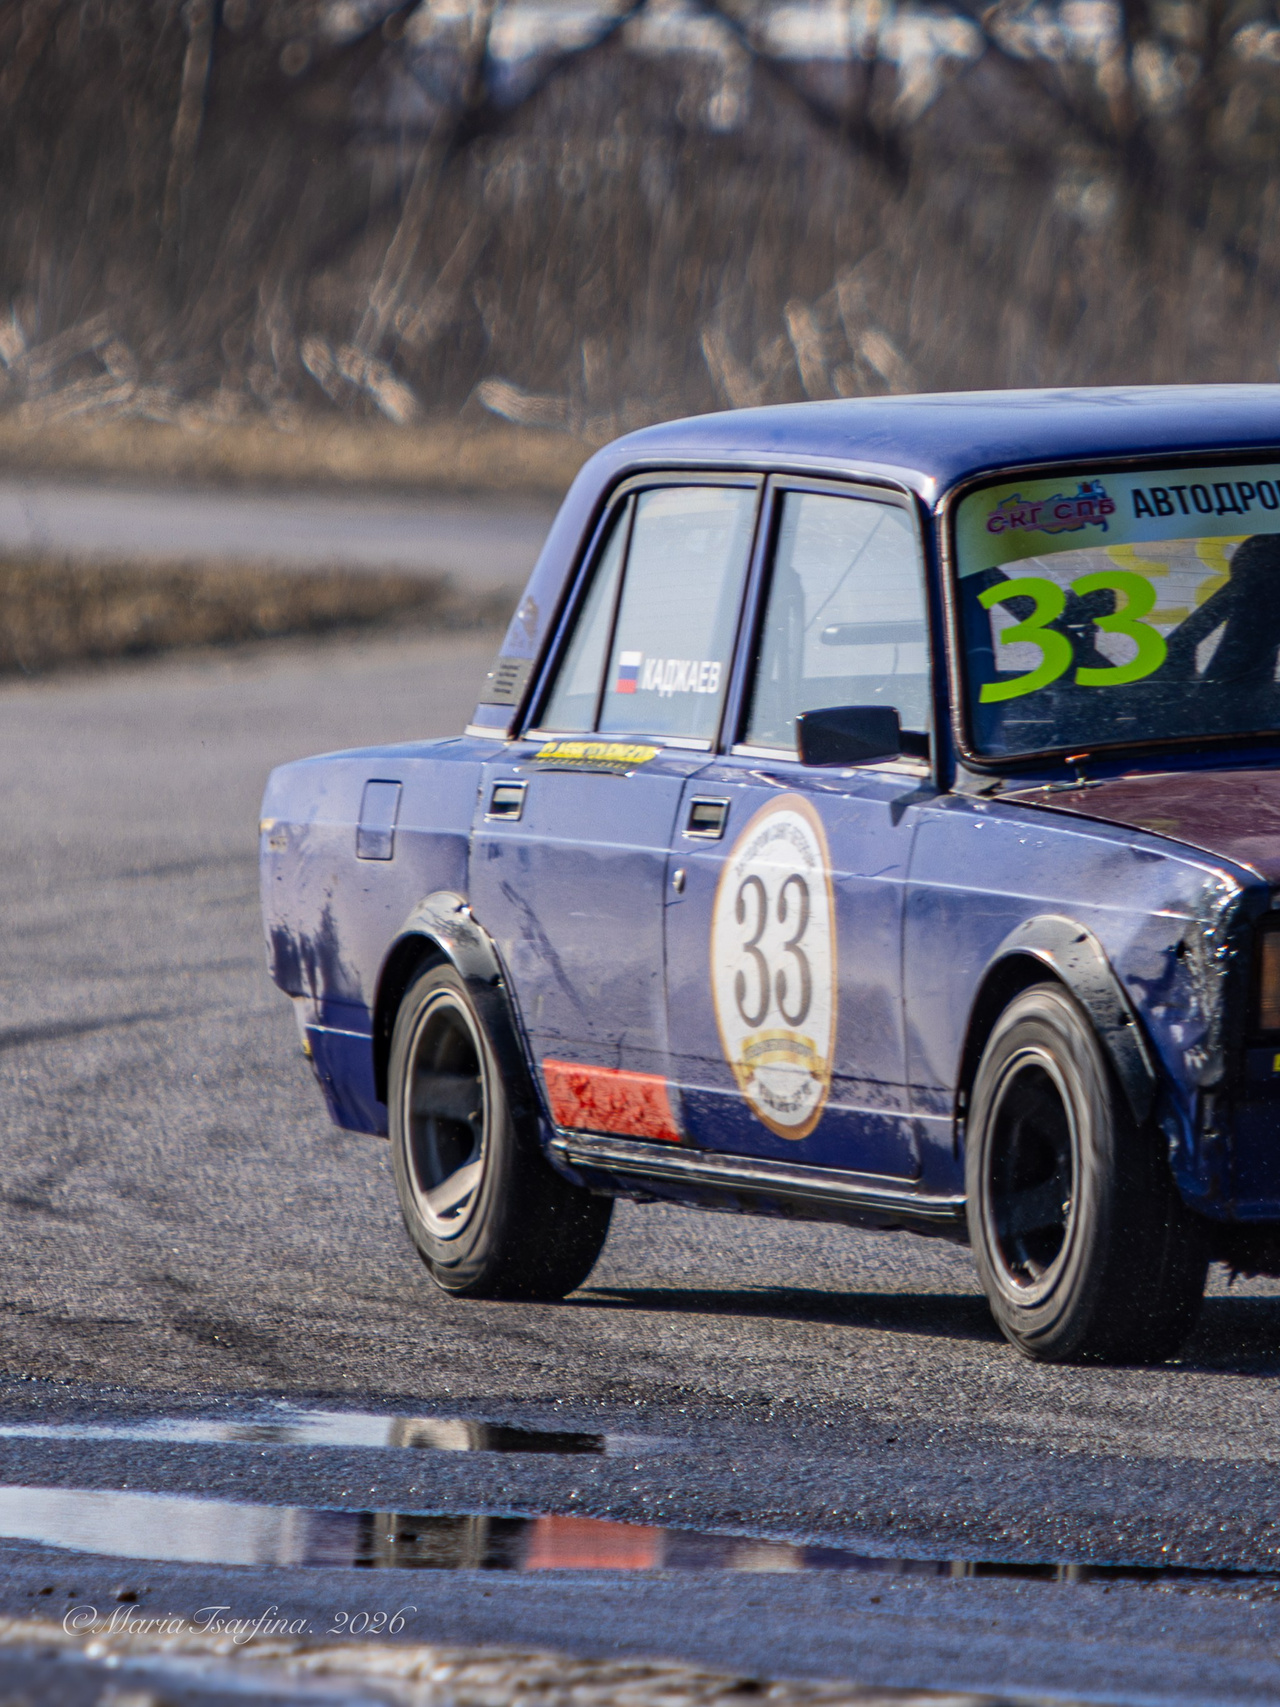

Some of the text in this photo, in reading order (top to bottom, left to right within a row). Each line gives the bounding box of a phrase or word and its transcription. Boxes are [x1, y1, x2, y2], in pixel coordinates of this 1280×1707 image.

[987, 498, 1116, 535] СКГ СПБ
[642, 658, 721, 697] КАДЖАЕВ
[977, 570, 1168, 705] 33
[735, 873, 812, 1028] 33
